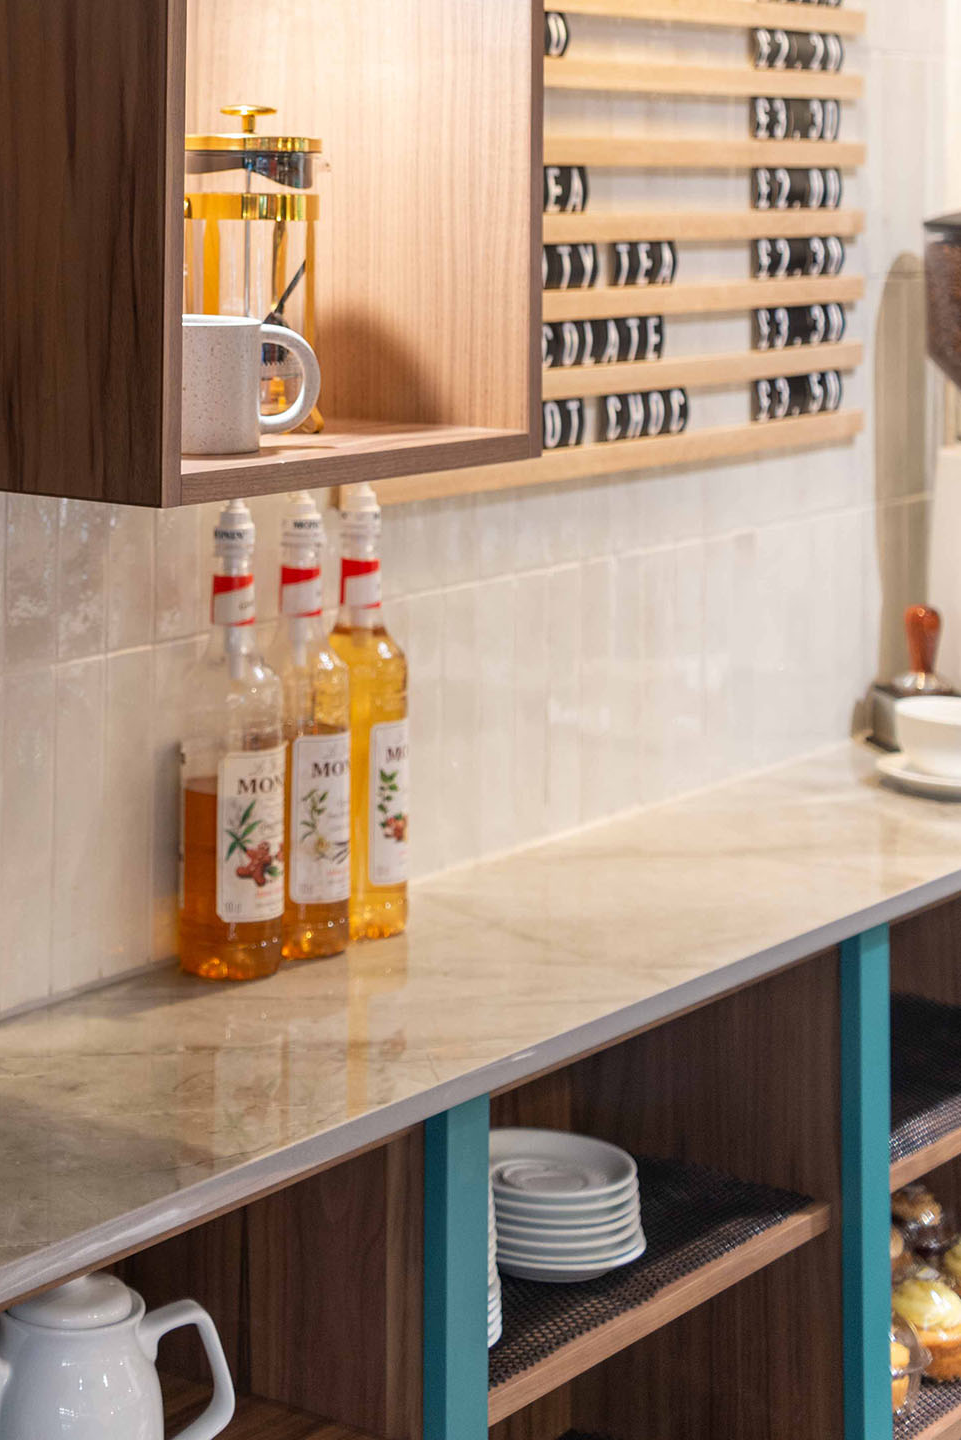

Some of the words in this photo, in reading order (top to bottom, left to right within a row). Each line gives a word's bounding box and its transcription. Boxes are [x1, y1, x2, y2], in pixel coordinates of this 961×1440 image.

[756, 29, 841, 73] £2.20
[756, 97, 839, 140] £3.30
[756, 168, 840, 210] £2.00
[542, 245, 594, 290] TY
[615, 242, 674, 288] TEA
[757, 237, 843, 280] £2.30
[757, 303, 844, 351] £3.30
[605, 388, 686, 442] CHOC
[757, 370, 841, 423] £3.50
